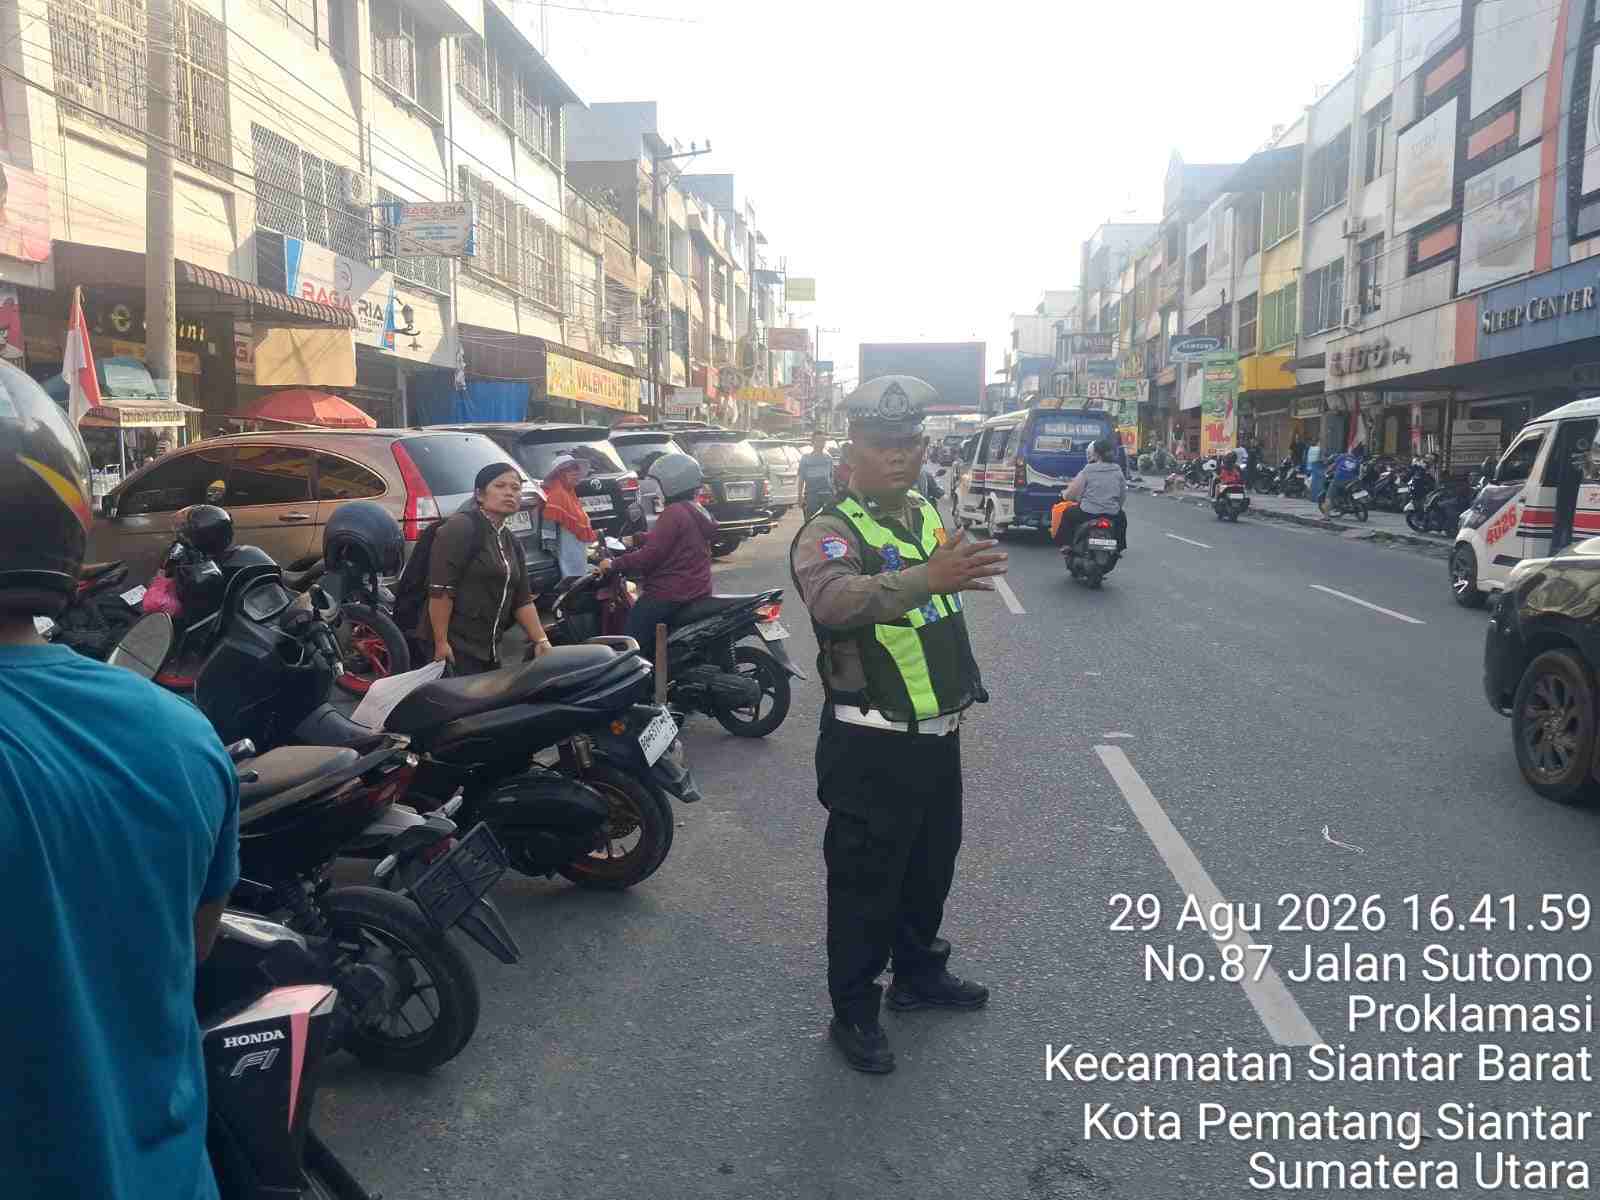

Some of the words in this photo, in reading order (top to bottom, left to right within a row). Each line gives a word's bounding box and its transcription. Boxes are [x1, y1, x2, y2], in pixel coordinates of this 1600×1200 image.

[302, 281, 352, 312] RAGA
[357, 298, 384, 321] RIA
[1482, 304, 1522, 335] SLEEP
[1526, 286, 1593, 322] CENTER
[1088, 380, 1145, 398] BEVY
[223, 1029, 285, 1048] HONDA
